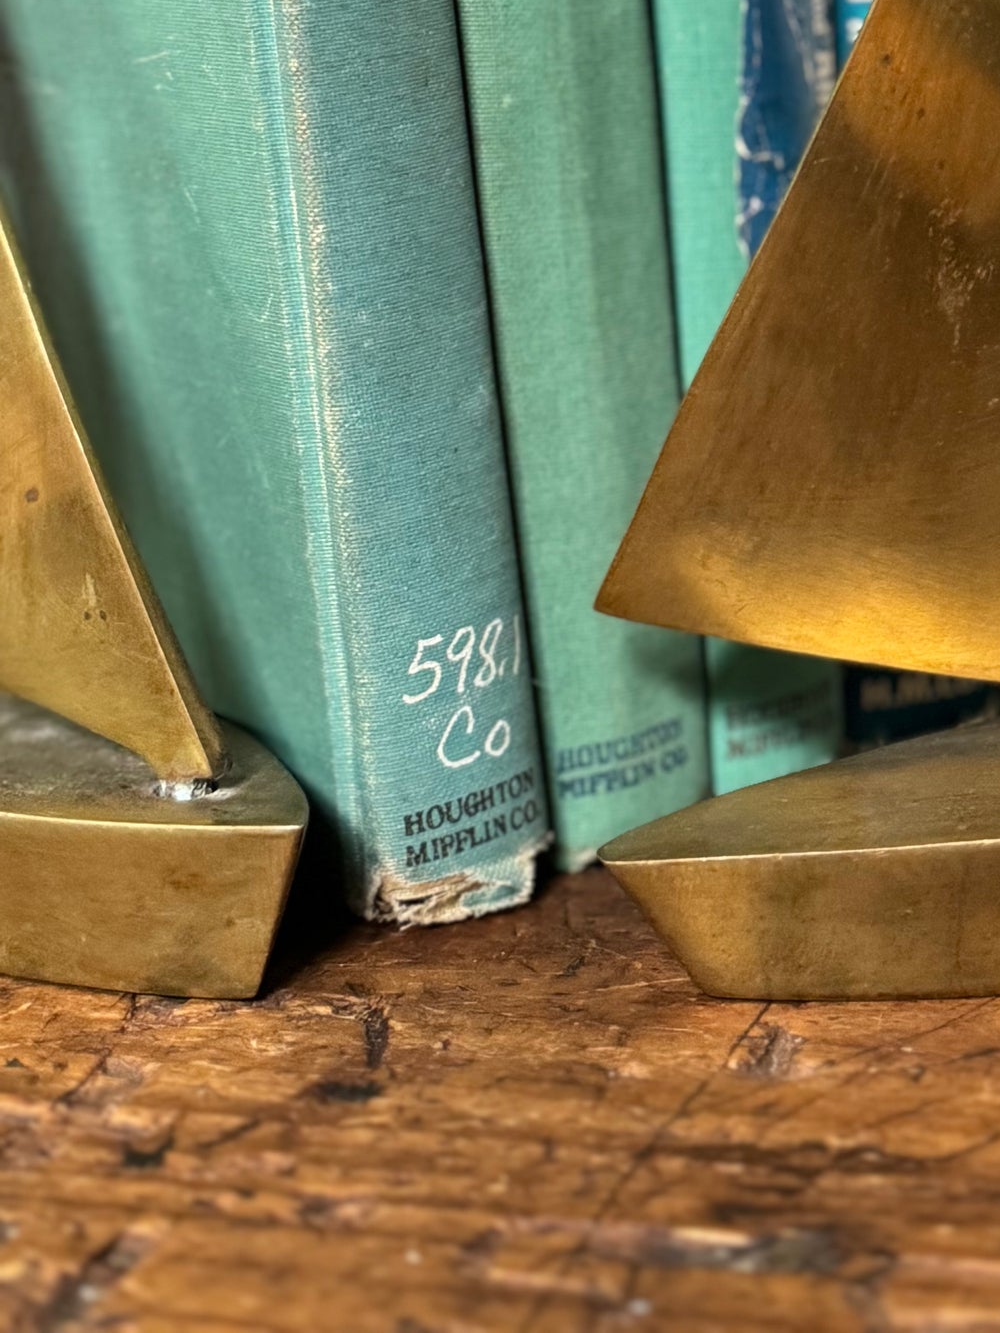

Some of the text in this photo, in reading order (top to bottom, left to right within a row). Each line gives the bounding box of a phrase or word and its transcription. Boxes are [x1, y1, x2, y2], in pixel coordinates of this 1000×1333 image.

[401, 615, 521, 704] 598.1
[436, 706, 512, 769] Co
[404, 768, 535, 836] HOUGHTON
